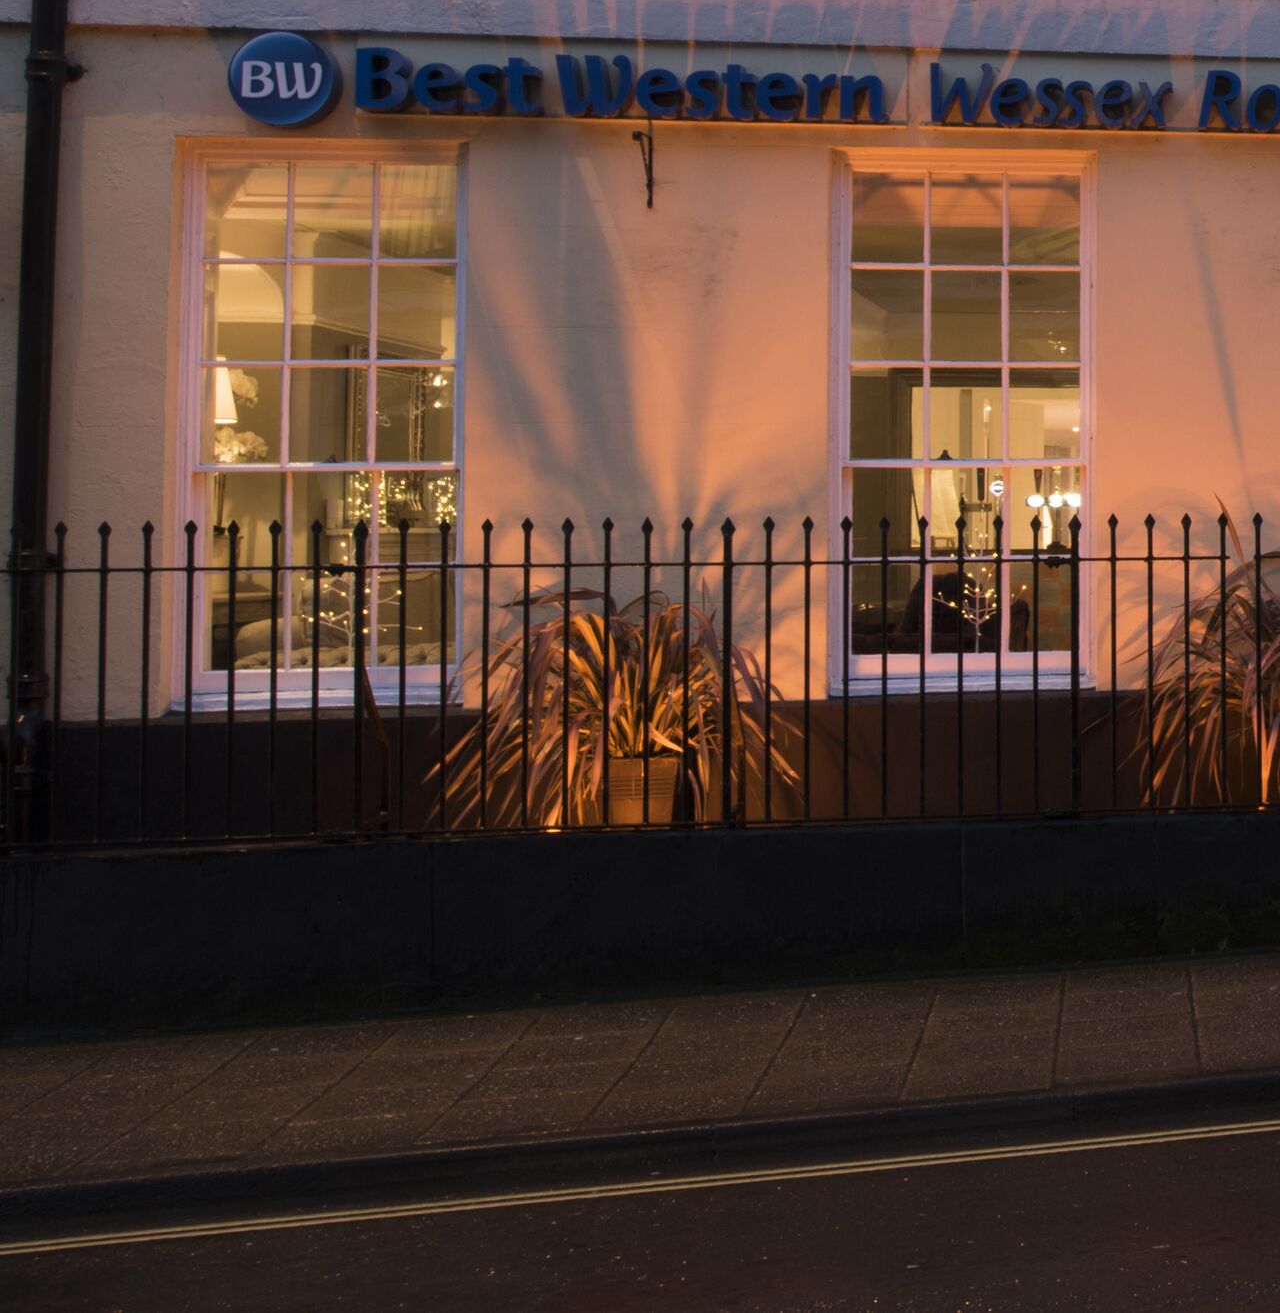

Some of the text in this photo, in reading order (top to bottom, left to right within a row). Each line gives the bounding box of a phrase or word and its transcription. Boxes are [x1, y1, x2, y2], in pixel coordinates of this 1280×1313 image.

[240, 59, 322, 101] BW
[355, 46, 543, 115] Best
[554, 53, 889, 123] Western
[930, 62, 1173, 130] Wessex
